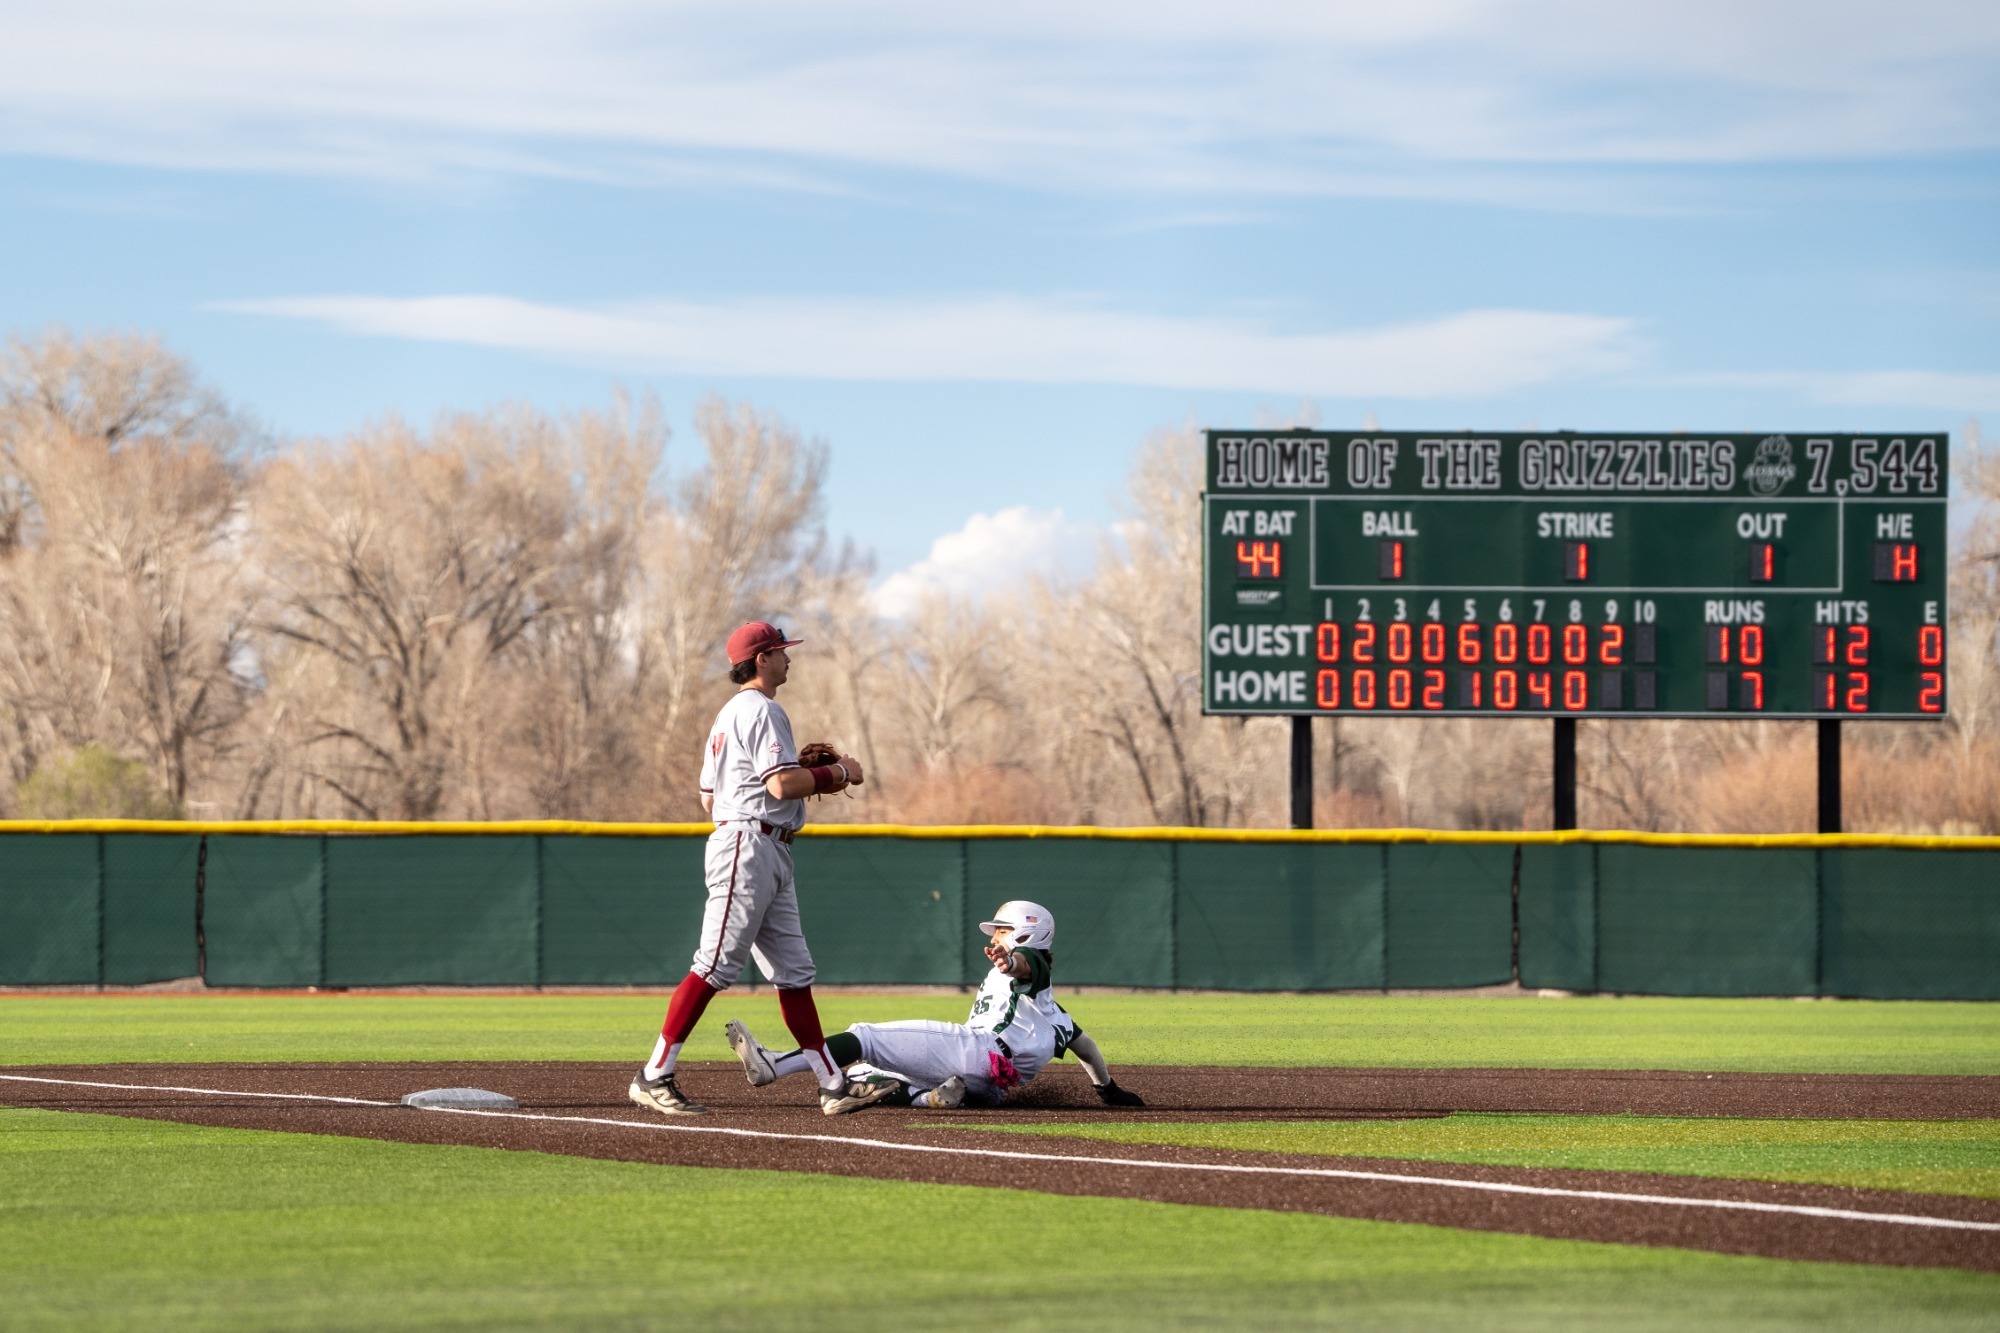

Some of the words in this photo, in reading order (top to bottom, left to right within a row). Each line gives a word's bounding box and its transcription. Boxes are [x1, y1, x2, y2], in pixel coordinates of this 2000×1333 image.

[1217, 438, 1329, 488] HOME
[1348, 439, 1398, 488] OF
[1417, 440, 1500, 488] THE
[1520, 440, 1735, 490] GRIZZLIES
[1807, 440, 1937, 495] 7,544
[1222, 510, 1249, 535] AT
[1255, 511, 1296, 536] BAT
[1363, 511, 1418, 536] BALL
[1538, 512, 1613, 537] STRIKE
[1737, 513, 1786, 538] OUT
[1878, 514, 1912, 538] H/E
[1237, 542, 1280, 576] 44
[1393, 543, 1402, 577] 1
[1578, 544, 1587, 578] 1
[1764, 545, 1773, 579] 1
[1893, 546, 1917, 580] H
[1326, 599, 1332, 620] 1
[1358, 599, 1370, 621] 2
[1394, 598, 1406, 621] 3
[1428, 600, 1440, 621] 4
[1465, 599, 1476, 621] 5
[1499, 599, 1512, 622] 6
[1534, 600, 1545, 621] 7
[1570, 600, 1581, 622] 8
[1606, 600, 1618, 622] 9
[1635, 601, 1655, 623] 10
[1705, 600, 1764, 623] RUNS
[1816, 601, 1868, 623] HITS
[1925, 601, 1937, 623] E
[1208, 624, 1312, 656] GUEST
[1317, 622, 1340, 663] 0
[1352, 622, 1376, 663] 2
[1388, 622, 1412, 663] 0
[1422, 623, 1445, 663] 0
[1458, 623, 1482, 664] 6
[1494, 624, 1518, 664] 0
[1527, 624, 1551, 664] 0
[1563, 624, 1587, 664] 0
[1600, 624, 1624, 665] 2
[1720, 625, 1763, 665] 10
[1826, 625, 1869, 666] 12
[1919, 626, 1943, 666] 0
[1215, 671, 1306, 702] HOME
[1316, 668, 1340, 709] 0
[1353, 669, 1376, 709] 0
[1388, 669, 1412, 709] 0
[1422, 669, 1446, 710] 2
[1472, 672, 1481, 706] 1
[1494, 669, 1518, 710] 0
[1528, 673, 1552, 707] 4
[1563, 670, 1588, 710] 0
[1742, 671, 1763, 708] 7
[1827, 672, 1869, 712] 12
[1919, 672, 1943, 712] 2
